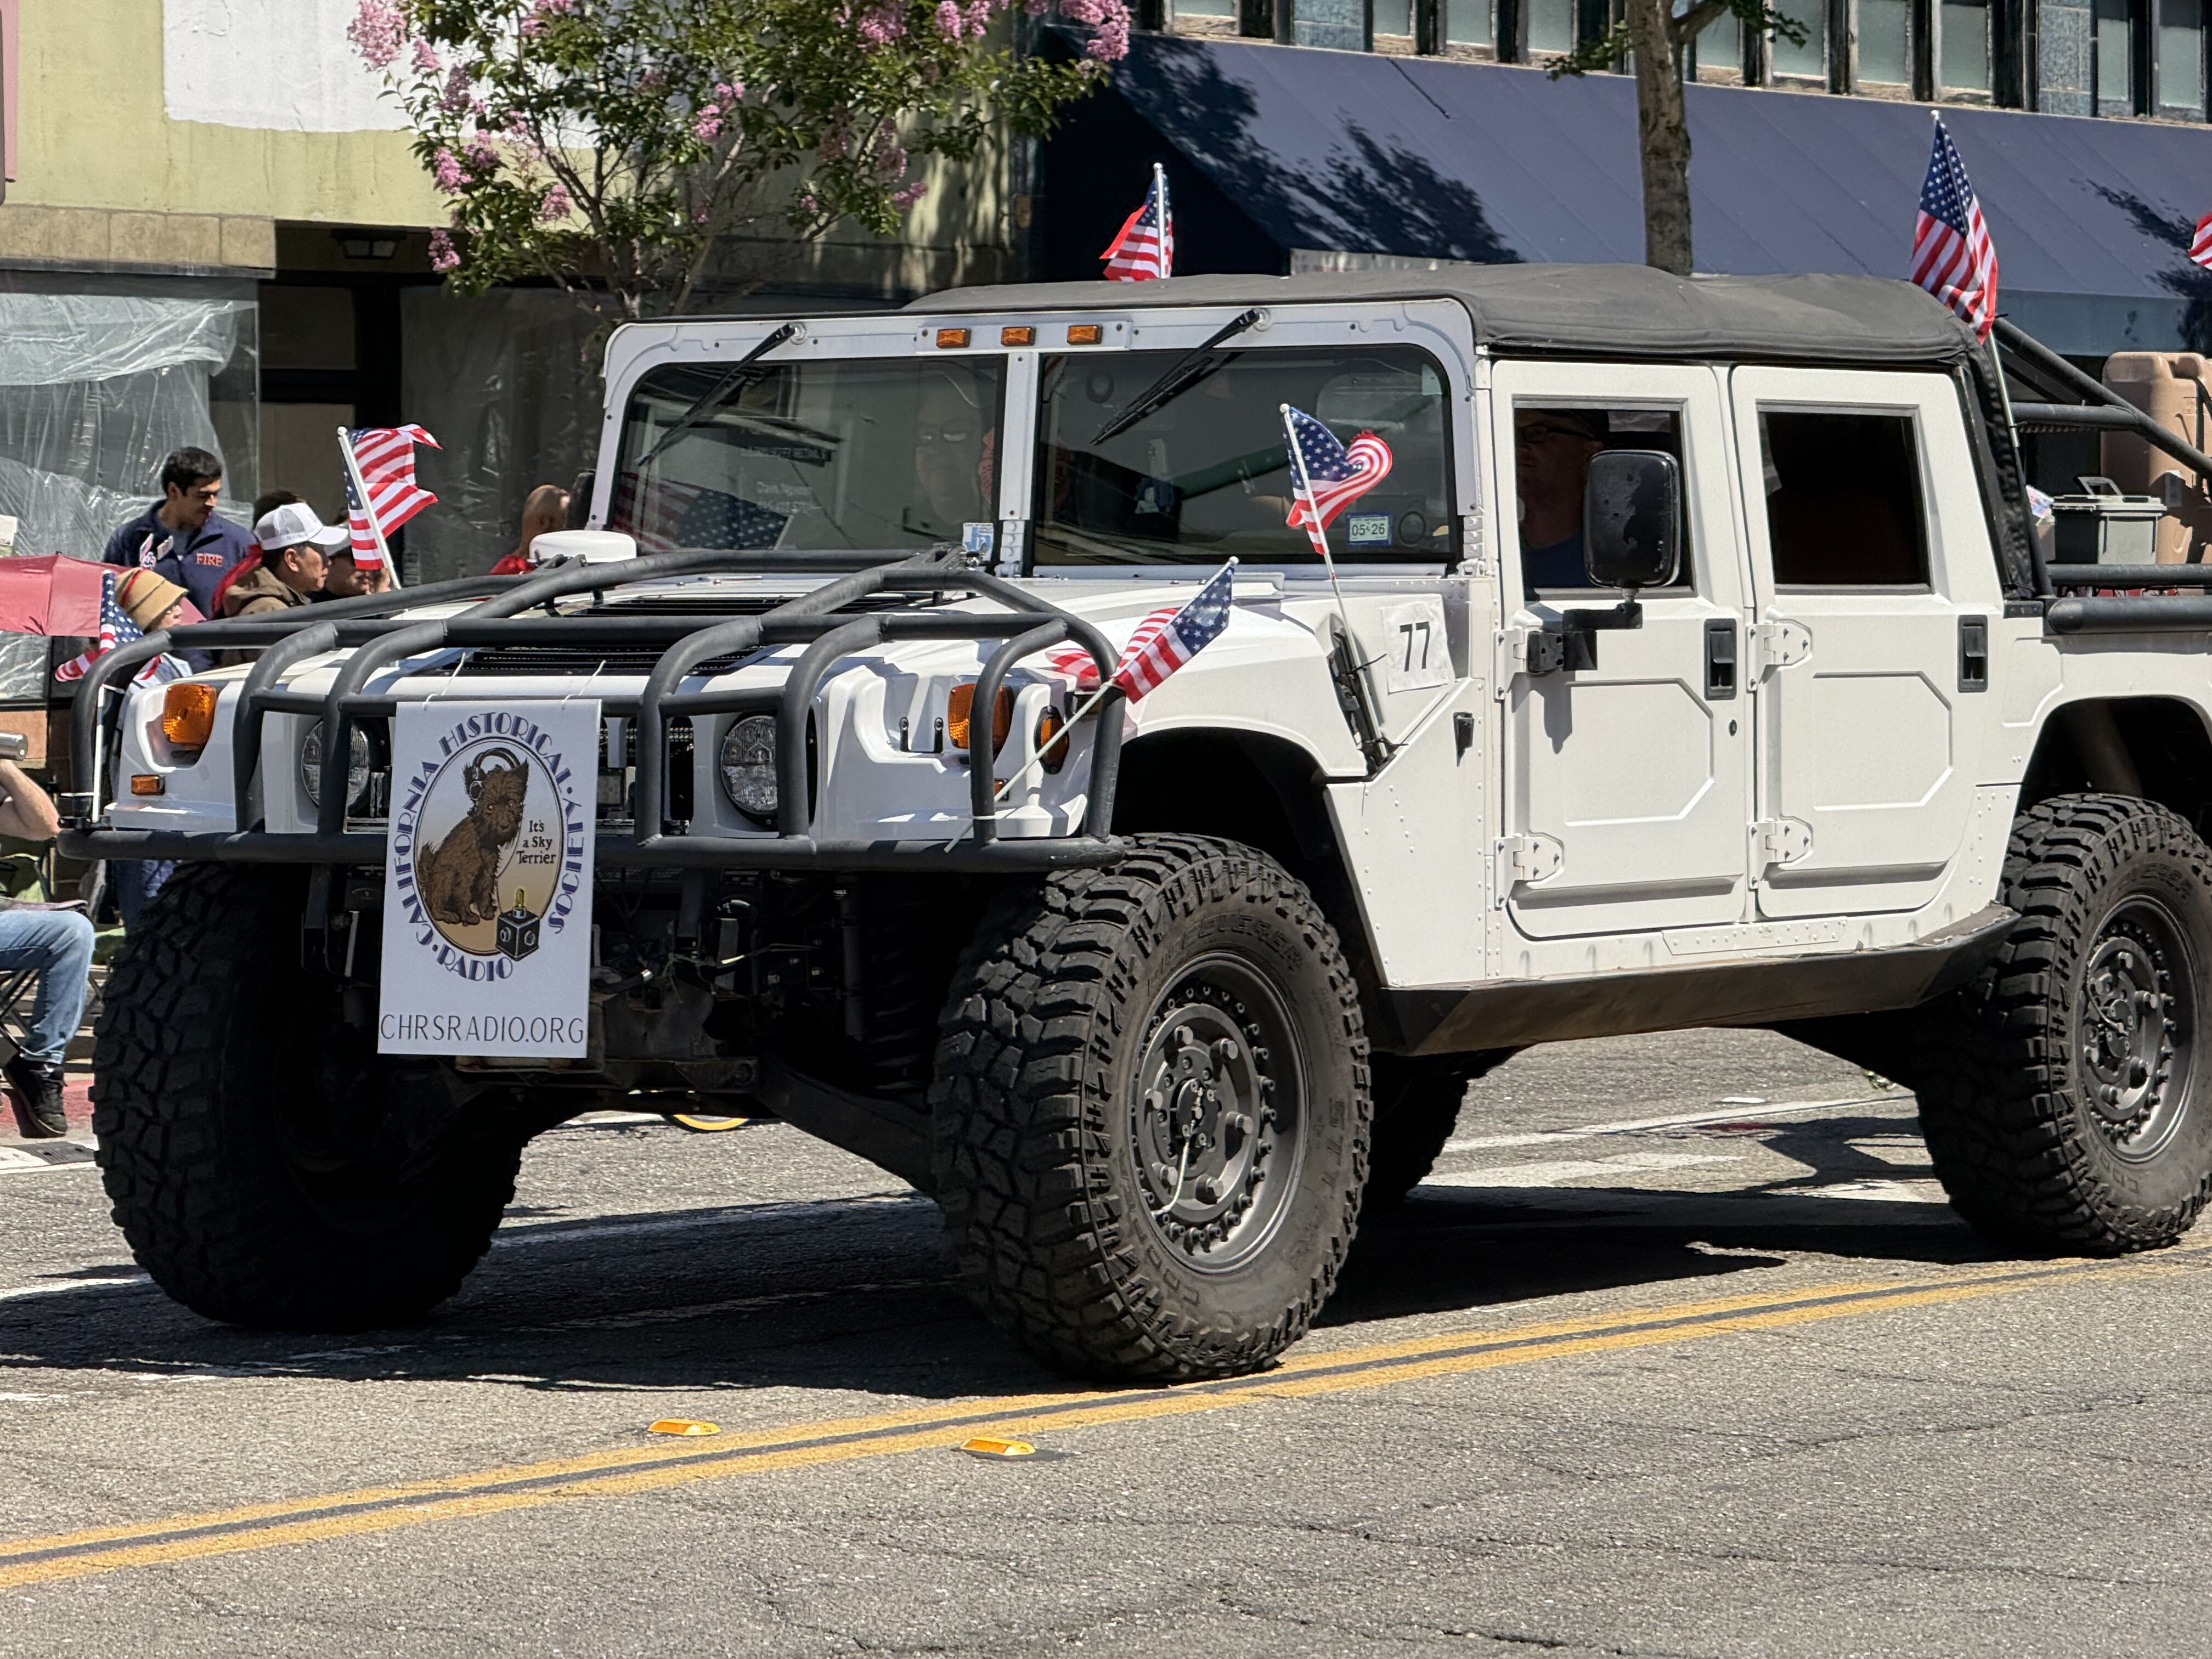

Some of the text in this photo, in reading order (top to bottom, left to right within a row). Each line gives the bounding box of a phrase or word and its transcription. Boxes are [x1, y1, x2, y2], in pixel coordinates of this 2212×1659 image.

[1352, 523, 1385, 535] 05 26
[196, 552, 223, 567] FIRE
[1400, 621, 1430, 672] 77
[394, 712, 571, 946] CALIFORNIA HISTORICAL
[528, 820, 545, 832] It's
[522, 836, 553, 850] a Sky
[516, 850, 556, 865] Terrier
[437, 798, 583, 981] RADIO SOCIETY
[381, 1014, 584, 1043] CHRSRADIO.ORG
